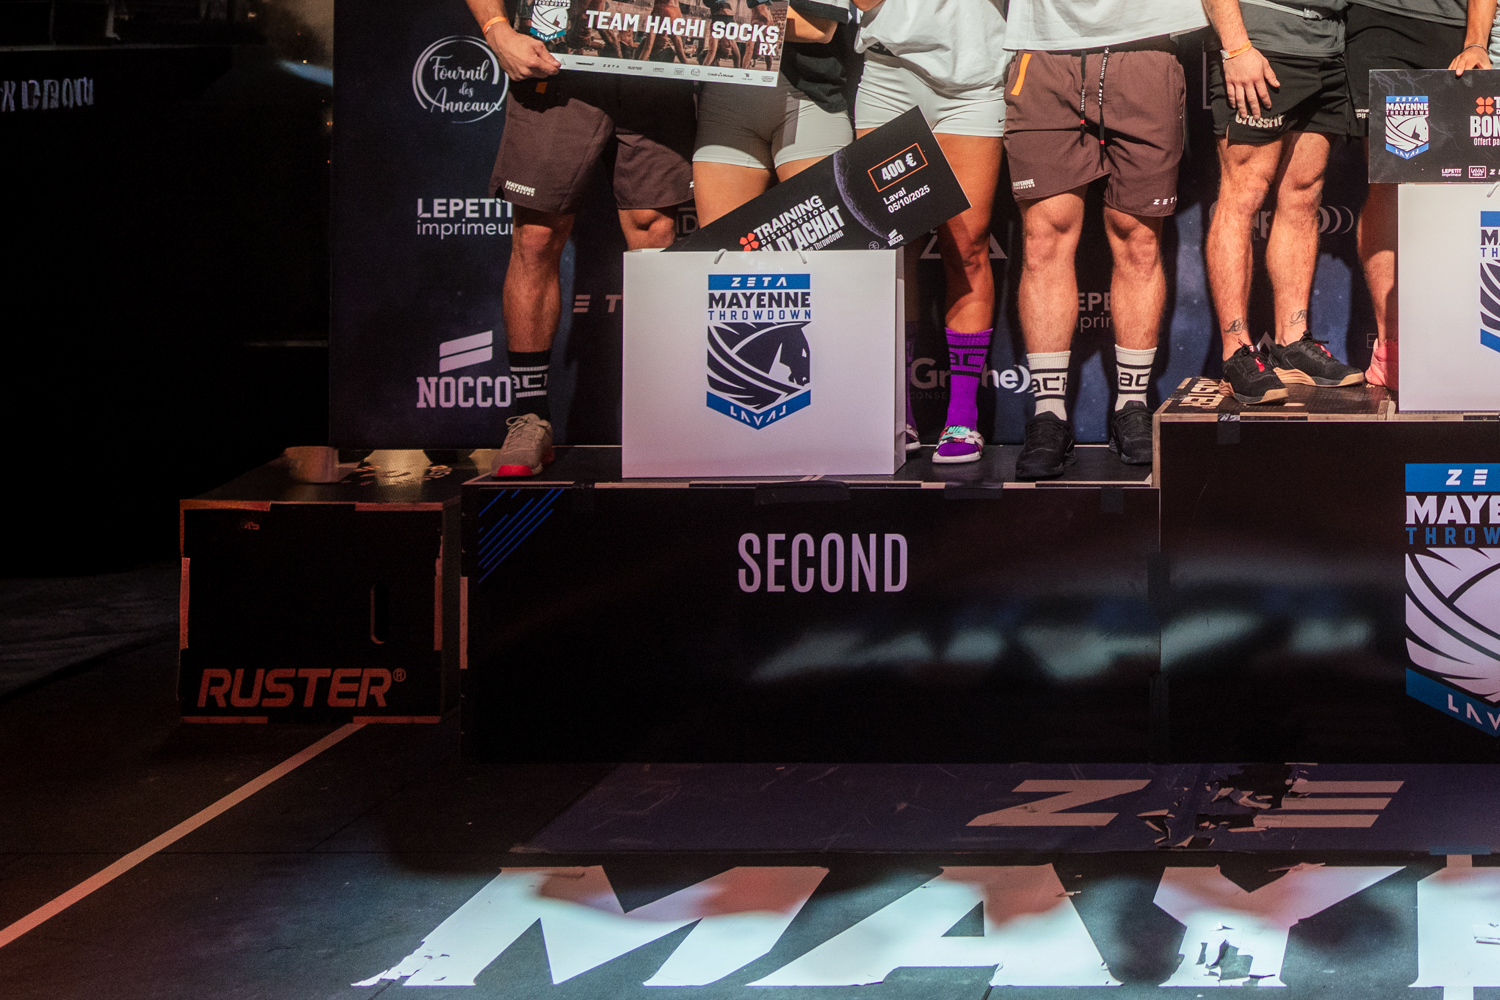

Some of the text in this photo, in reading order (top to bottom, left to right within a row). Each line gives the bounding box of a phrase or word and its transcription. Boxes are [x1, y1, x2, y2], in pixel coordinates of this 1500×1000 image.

[586, 10, 779, 43] TEAM HACHI SOCKS
[759, 42, 777, 56] RX
[430, 55, 488, 81] Fournil
[429, 87, 502, 113] Anneaux
[459, 82, 474, 96] des
[1386, 103, 1428, 111] MAYENNE
[1474, 137, 1491, 146] Offert
[881, 152, 917, 181] 400 €
[883, 187, 906, 205] Laval
[887, 184, 931, 214] 05/10/2025
[753, 195, 823, 239] TRAINING
[760, 205, 826, 245] DISTRIBUTION
[731, 277, 788, 288] ZETA
[708, 292, 811, 308] MAYENNE
[708, 310, 811, 320] THROWDOWN
[416, 376, 511, 408] NOCCO
[738, 532, 908, 593] SECOND
